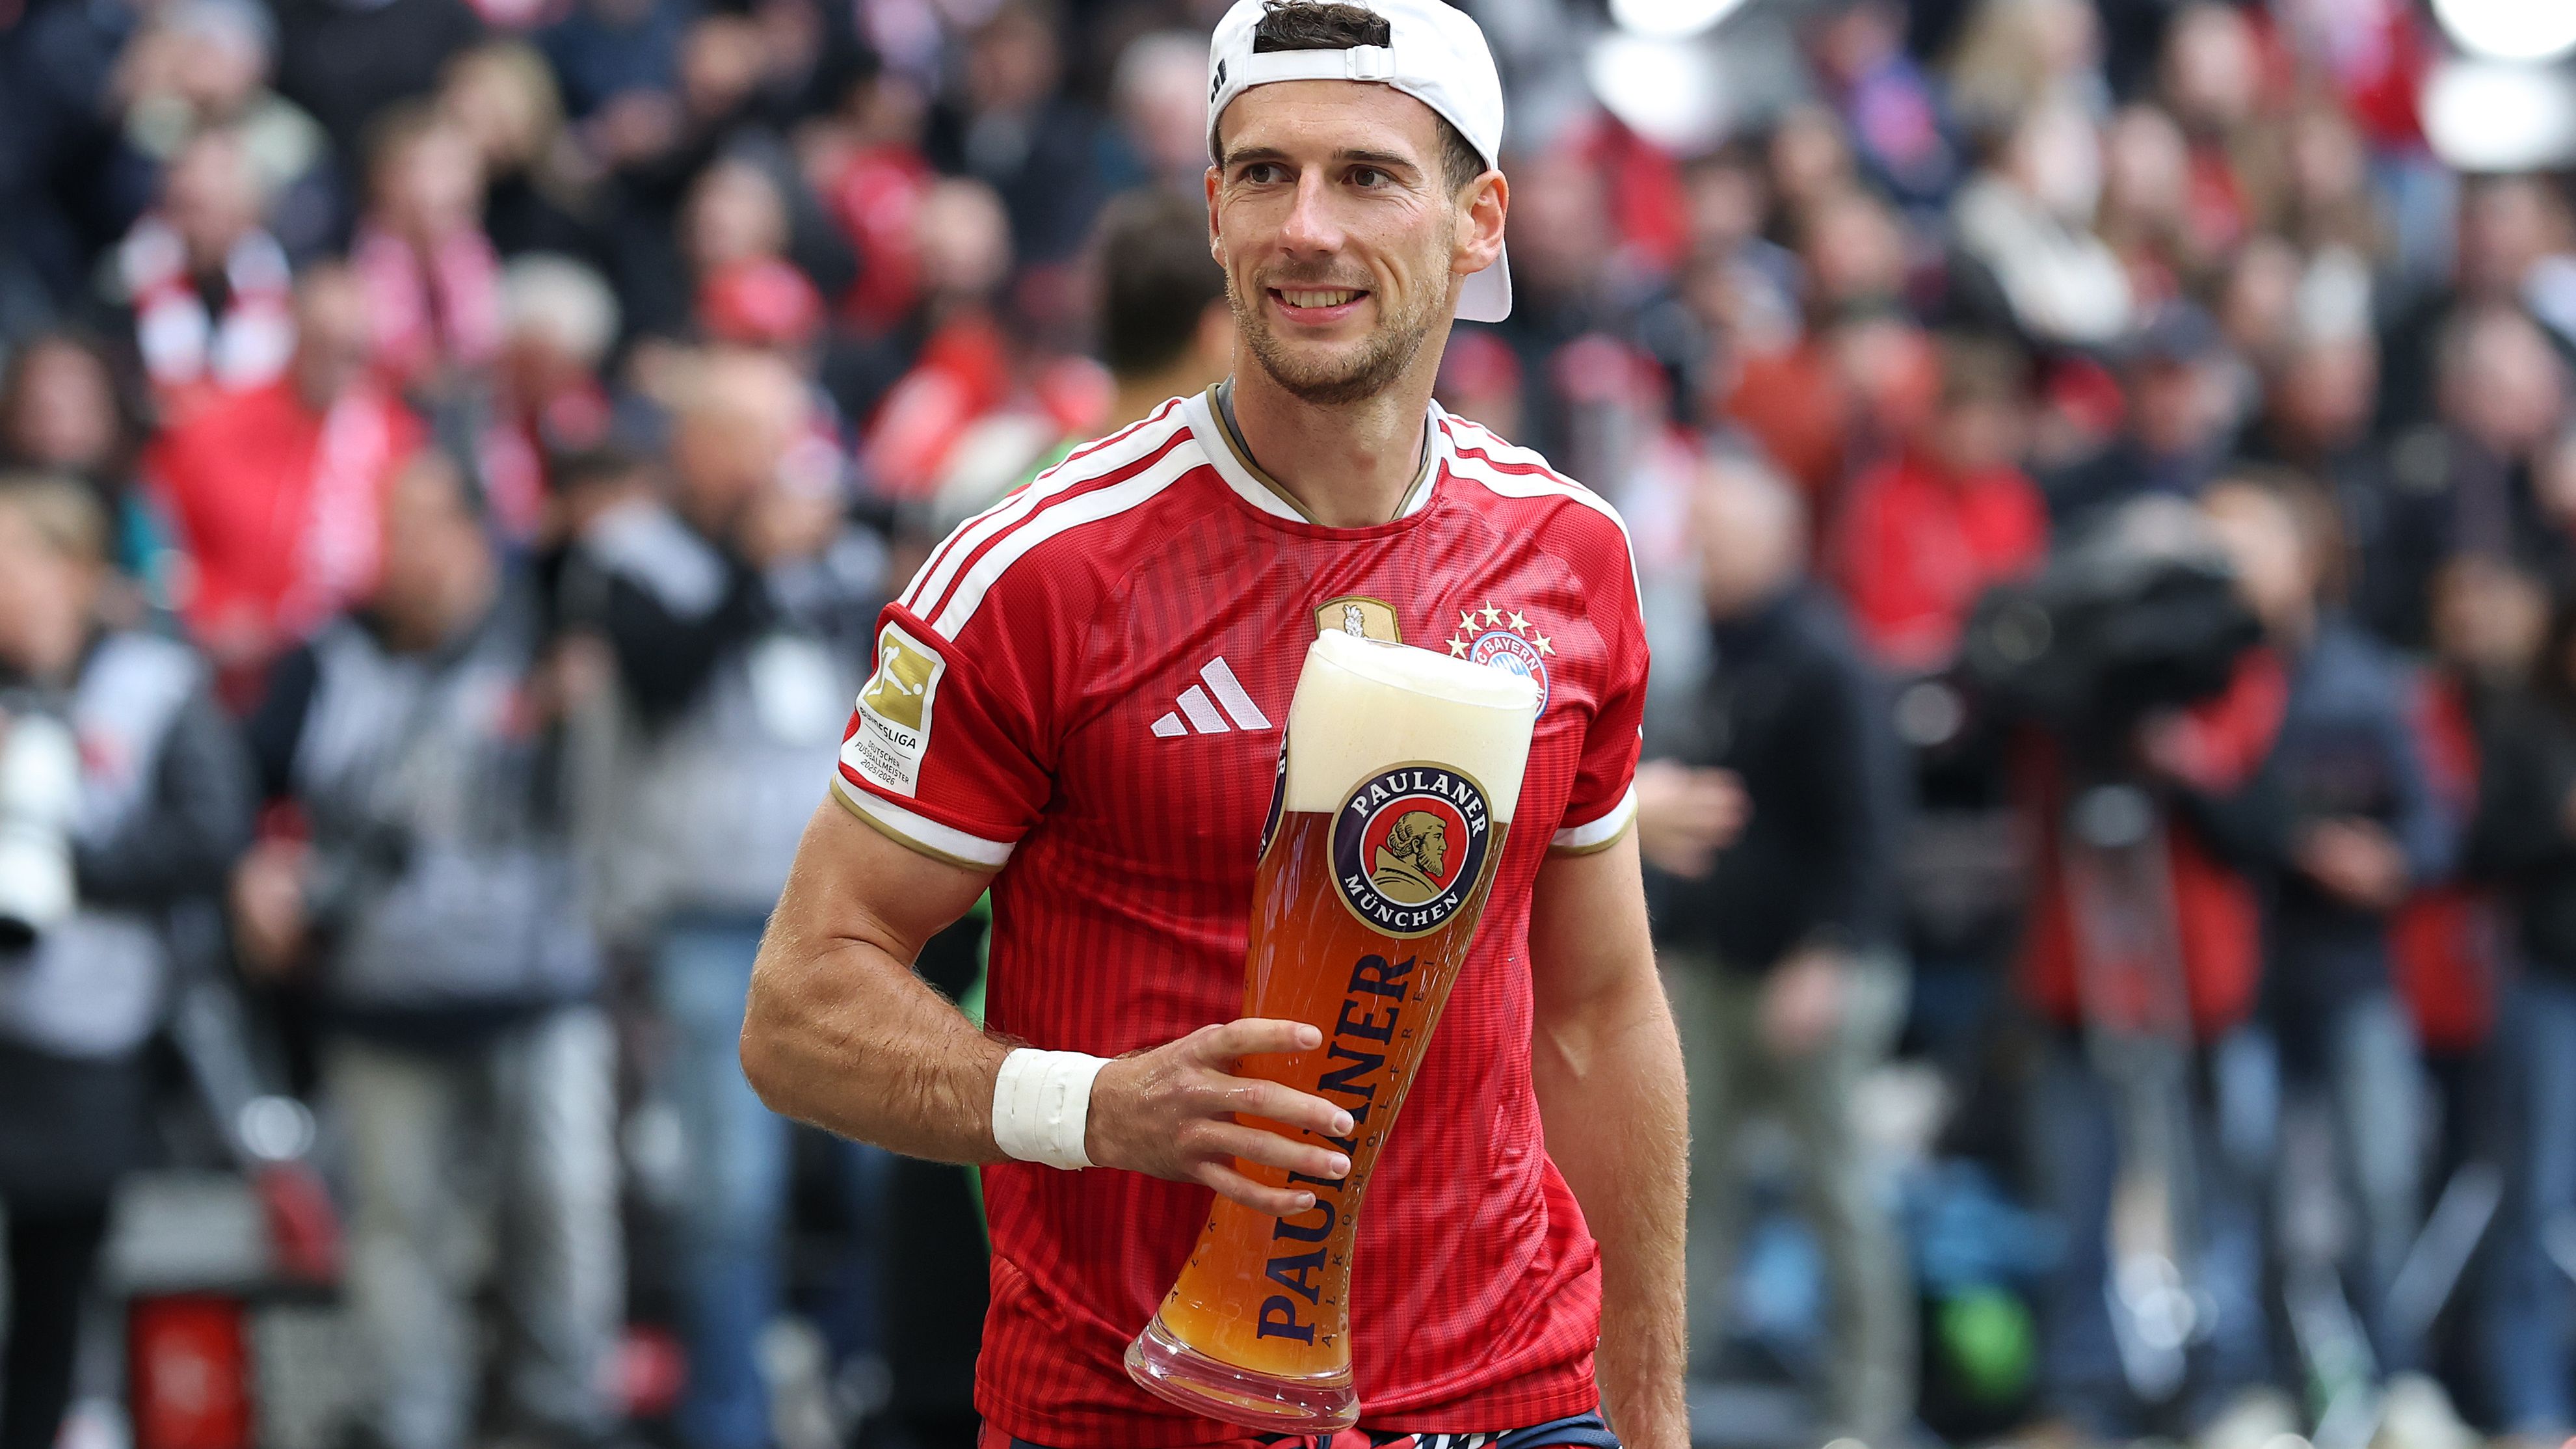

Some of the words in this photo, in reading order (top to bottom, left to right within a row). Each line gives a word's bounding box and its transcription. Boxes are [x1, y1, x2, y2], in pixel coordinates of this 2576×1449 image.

[1483, 637, 1539, 671] BAYERN
[855, 741, 910, 785] FUSSBALLMEISTER
[860, 758, 896, 786] 2025/2026
[868, 740, 901, 769] DEUTSCHER
[1351, 771, 1487, 838] PAULANER
[1344, 874, 1460, 927] MÜNCHEN
[1321, 959, 1435, 1348] ALKOHOLFREI
